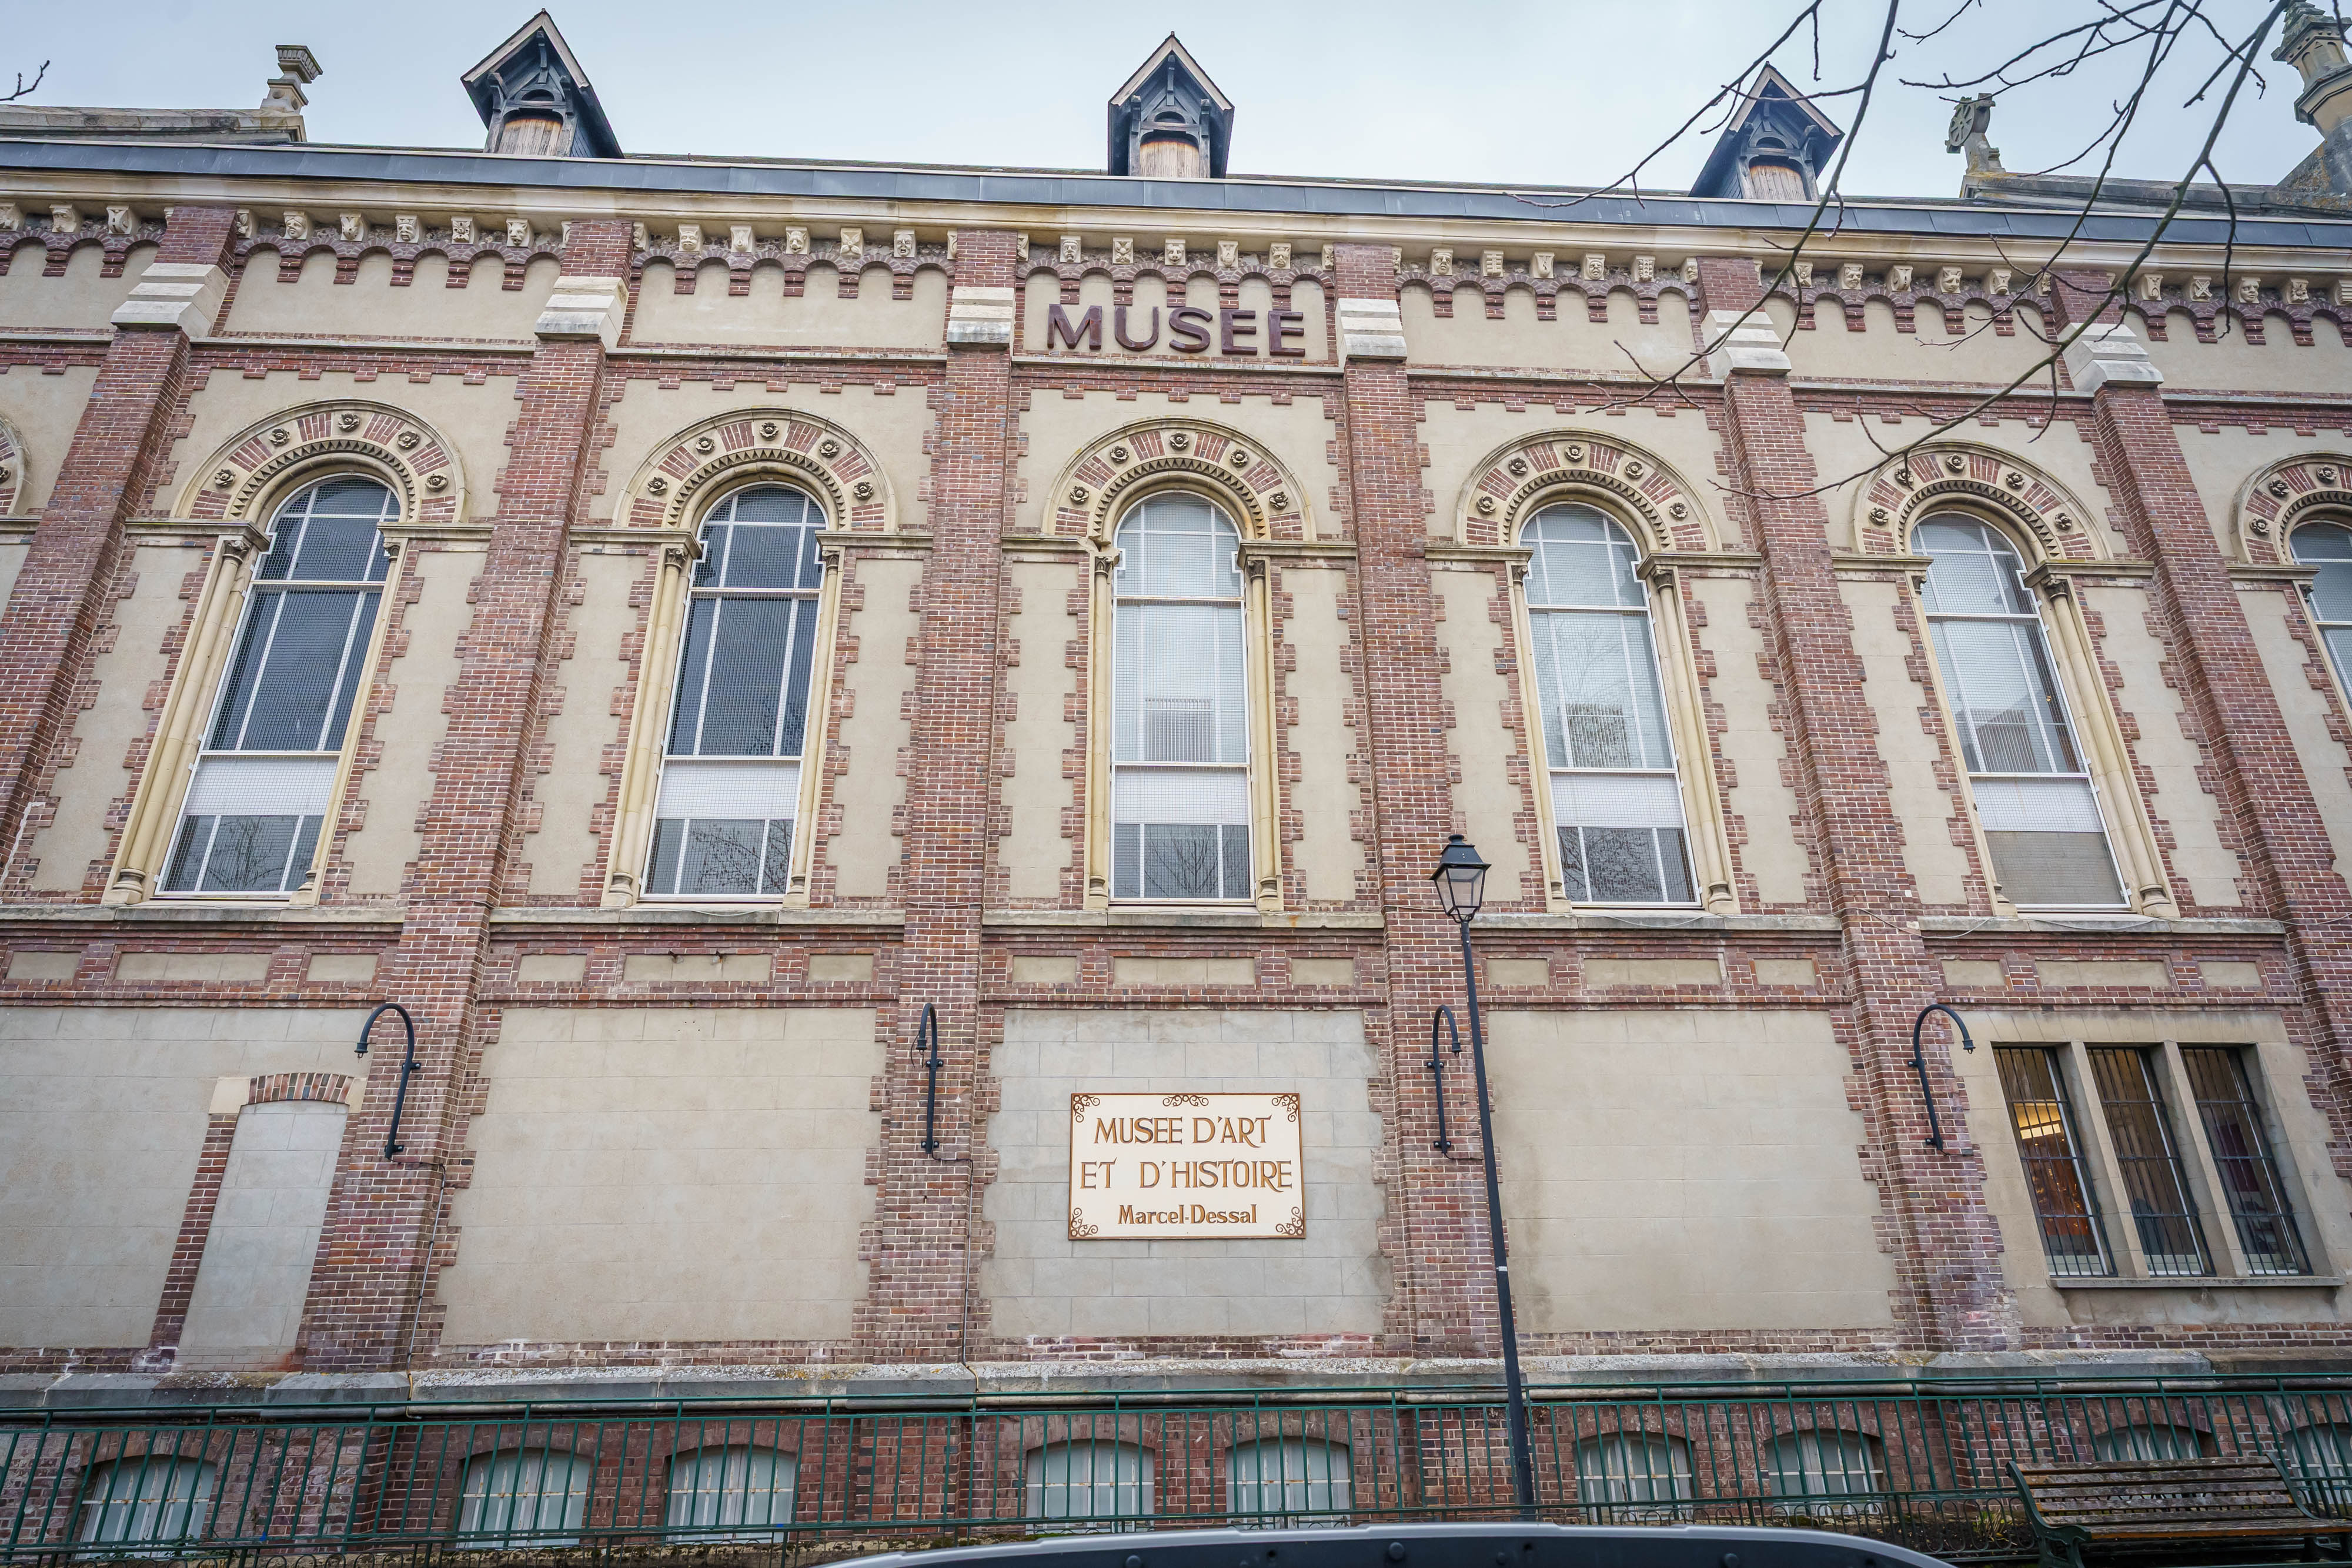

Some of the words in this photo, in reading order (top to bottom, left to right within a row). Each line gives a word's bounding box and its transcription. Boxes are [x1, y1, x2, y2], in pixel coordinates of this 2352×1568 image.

[1047, 303, 1305, 356] MUSEE
[1094, 1116, 1182, 1145] MUSEE
[1192, 1114, 1272, 1148] D'ART
[1080, 1157, 1117, 1189] ET
